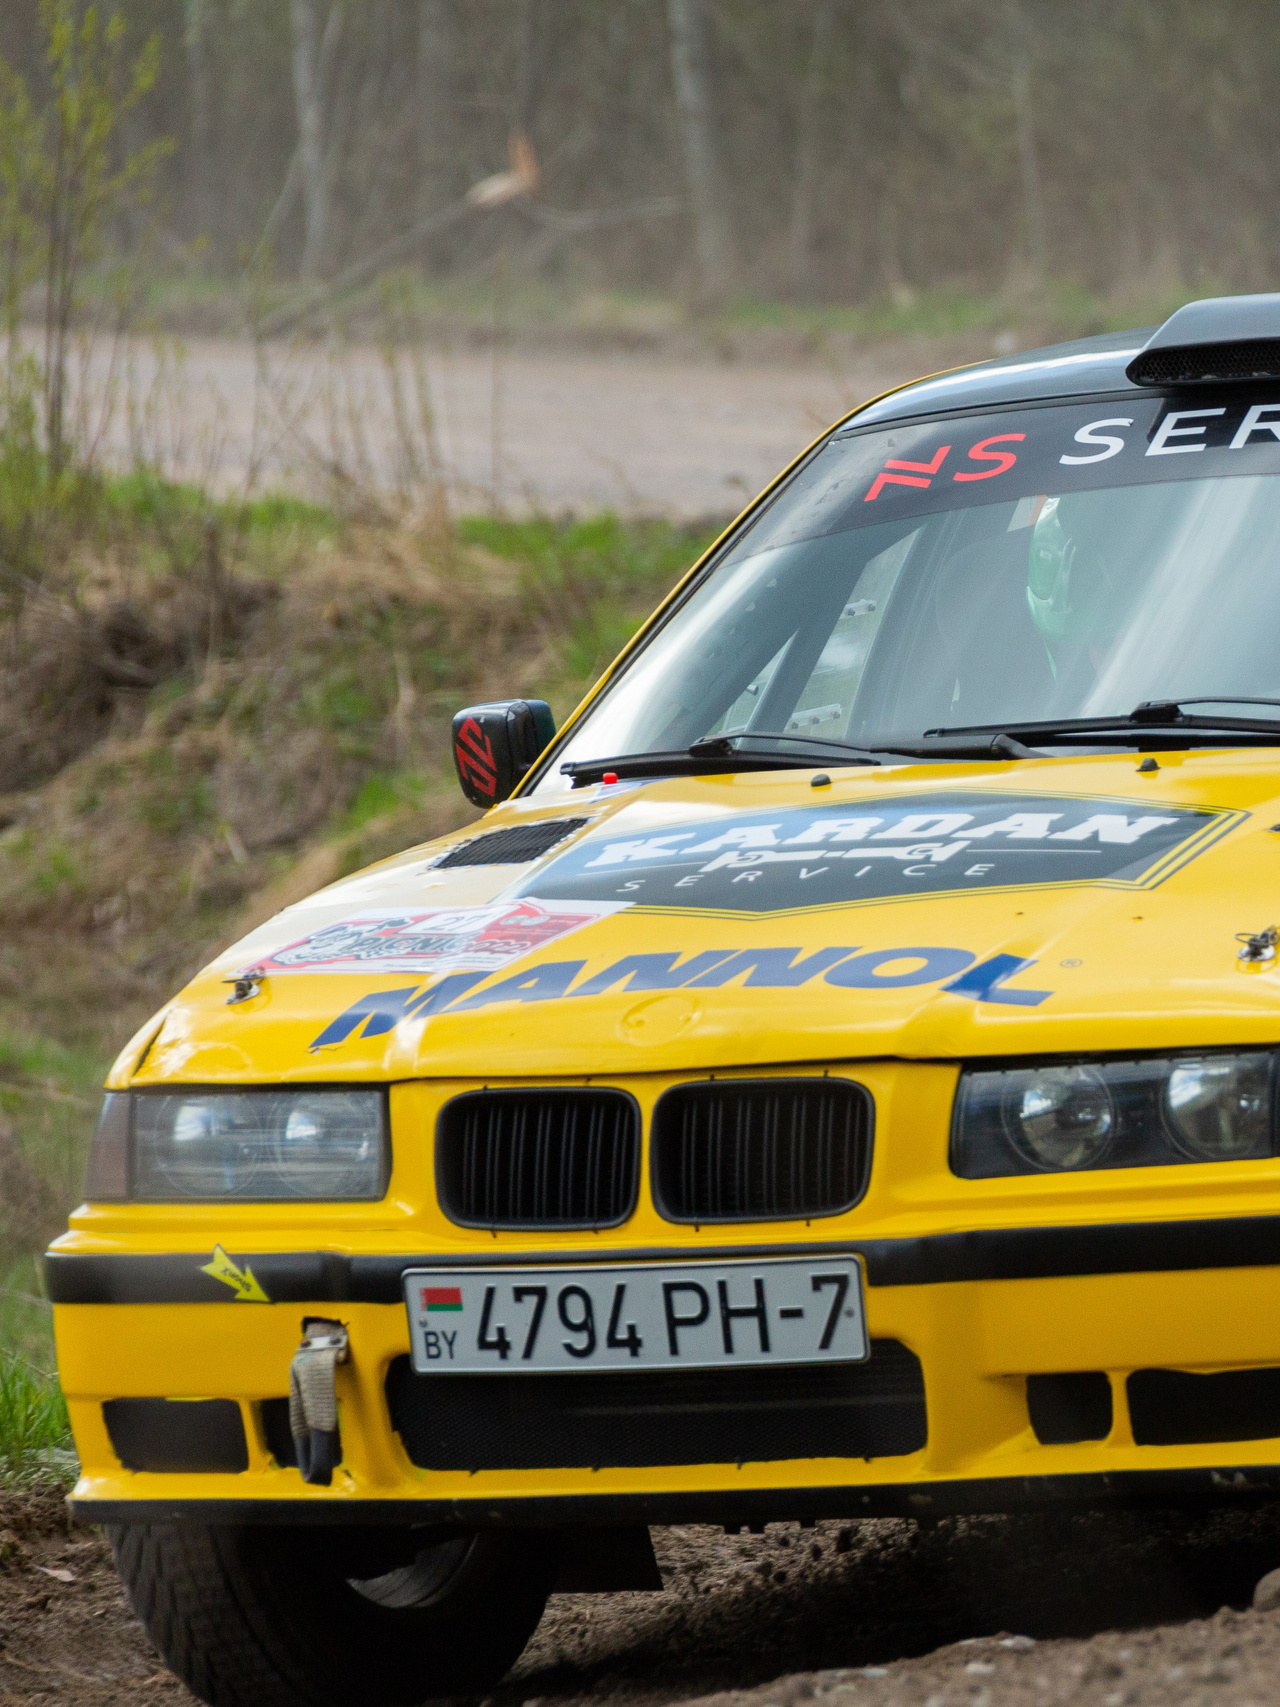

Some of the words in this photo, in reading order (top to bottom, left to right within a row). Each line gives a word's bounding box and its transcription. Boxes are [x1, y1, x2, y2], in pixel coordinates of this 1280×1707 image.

[583, 813, 1179, 867] KARDAN
[616, 863, 996, 892] SERVICE
[308, 946, 1052, 1050] MANNOL
[476, 1282, 642, 1360] 4794
[661, 1272, 850, 1357] PH-7
[424, 1331, 457, 1360] BY
